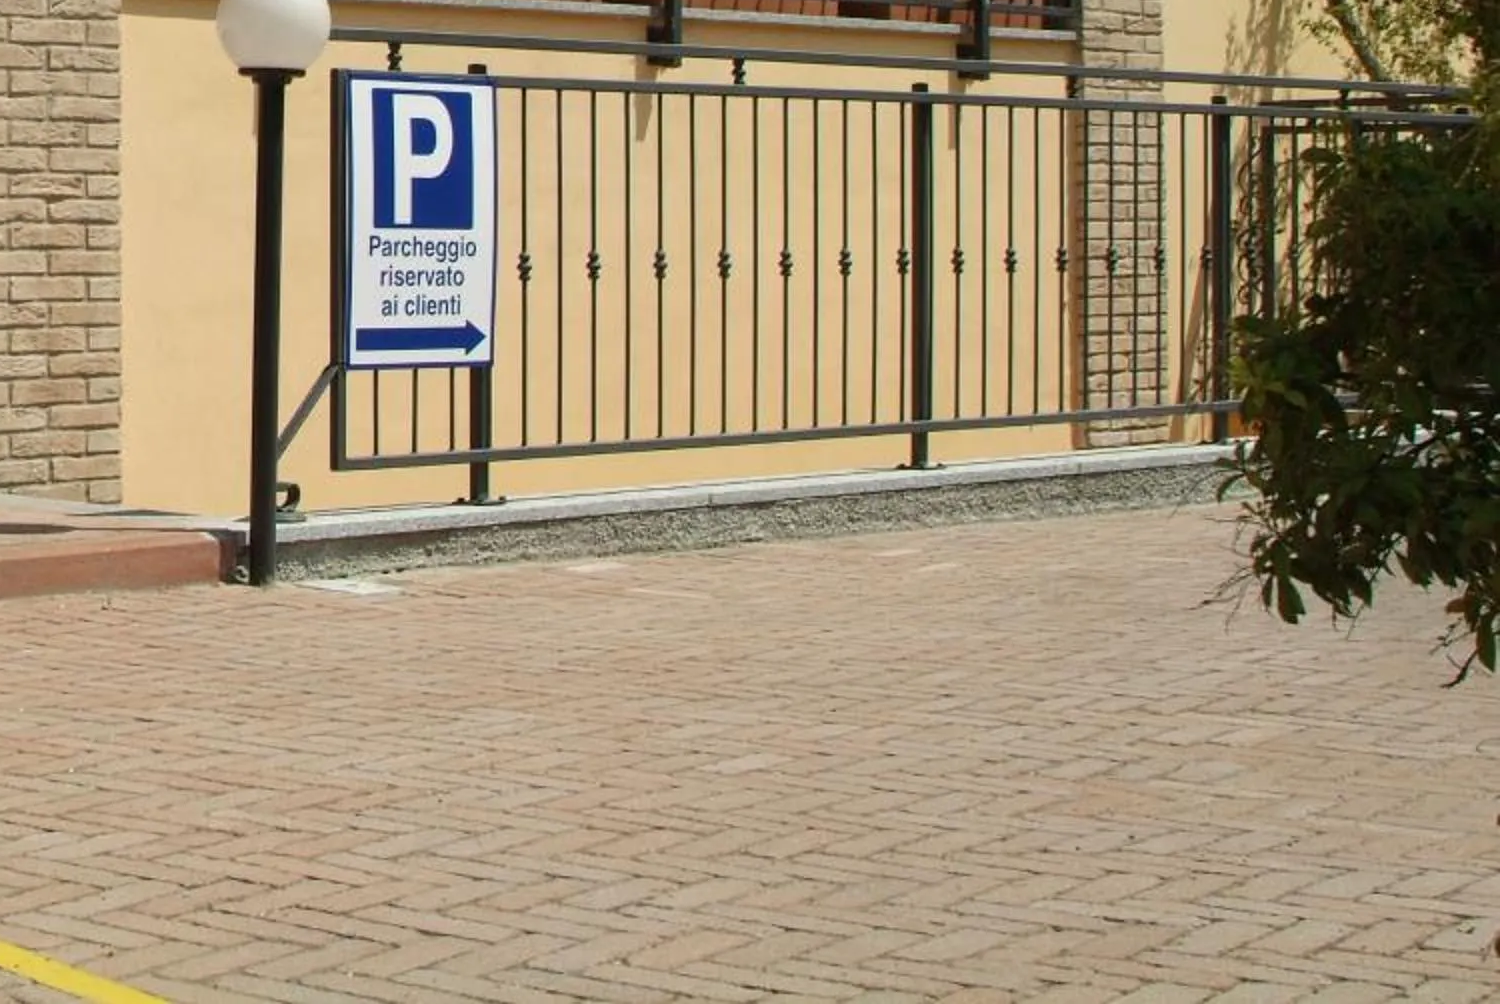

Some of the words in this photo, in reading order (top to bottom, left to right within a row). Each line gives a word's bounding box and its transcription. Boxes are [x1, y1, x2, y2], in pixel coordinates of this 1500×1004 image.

[393, 93, 453, 225] P
[369, 235, 477, 262] Parcheggio
[379, 264, 465, 287] riservato
[381, 295, 398, 316] ai
[405, 294, 461, 316] clienti
